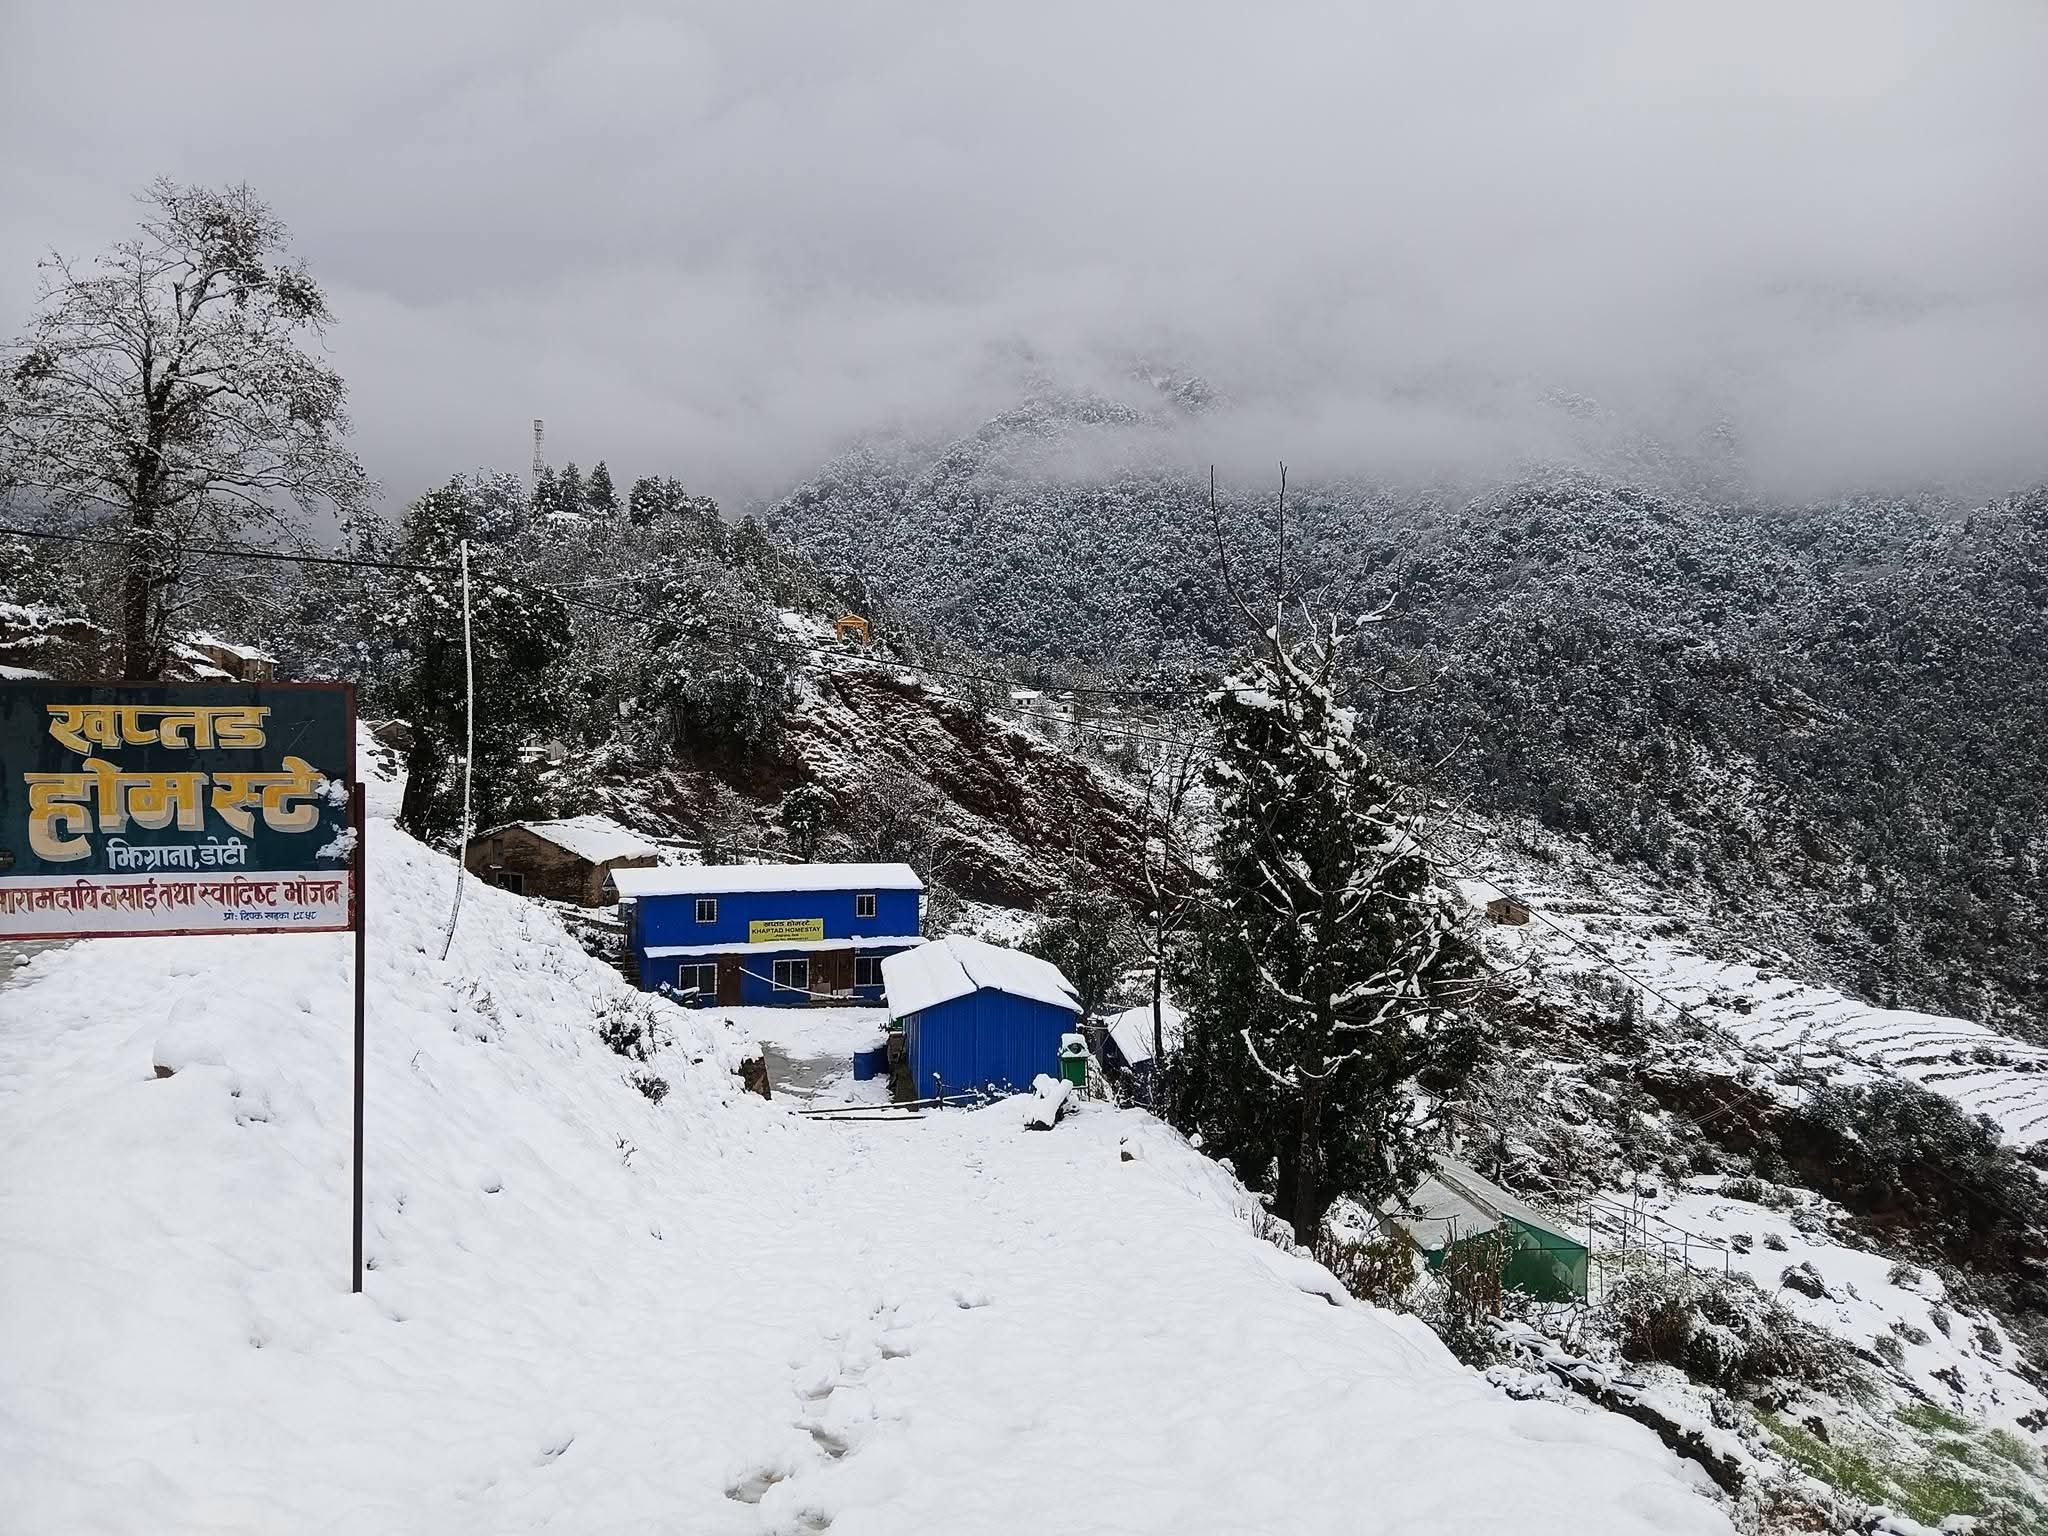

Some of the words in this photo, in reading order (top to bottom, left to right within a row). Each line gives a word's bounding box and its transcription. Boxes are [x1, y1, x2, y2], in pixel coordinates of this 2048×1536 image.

[47, 704, 272, 757] खप्तड
[23, 757, 210, 863] होम
[199, 836, 248, 866] डोटी
[159, 882, 198, 912] तथा
[199, 875, 280, 911] स्वादिष्ट
[282, 875, 344, 908] भोजन
